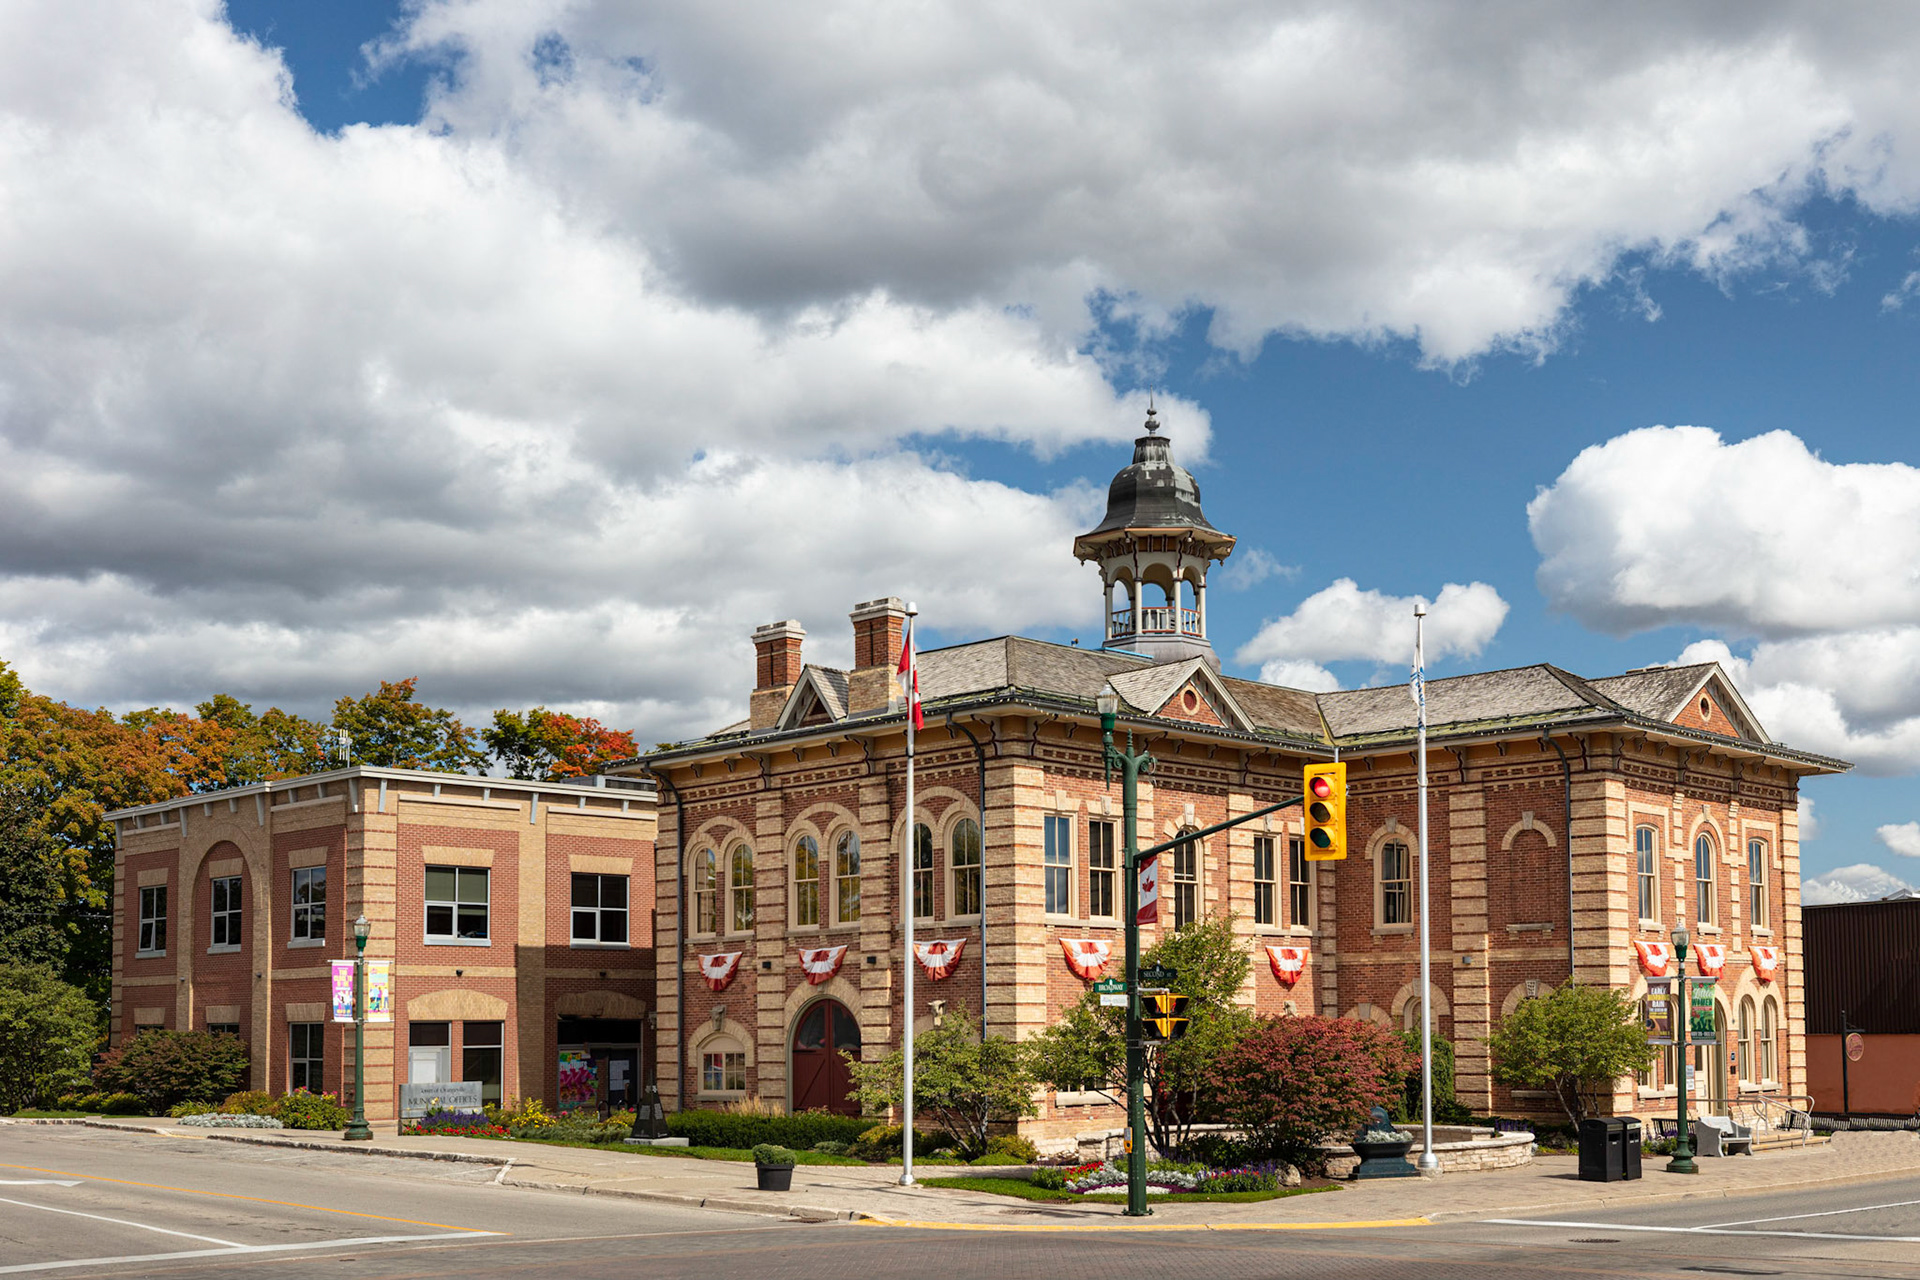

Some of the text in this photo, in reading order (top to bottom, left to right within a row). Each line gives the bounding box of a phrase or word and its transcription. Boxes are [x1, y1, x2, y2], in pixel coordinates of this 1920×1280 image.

[1143, 970, 1165, 978] SECOND
[408, 1095, 477, 1105] MUNICAL OFFICES
